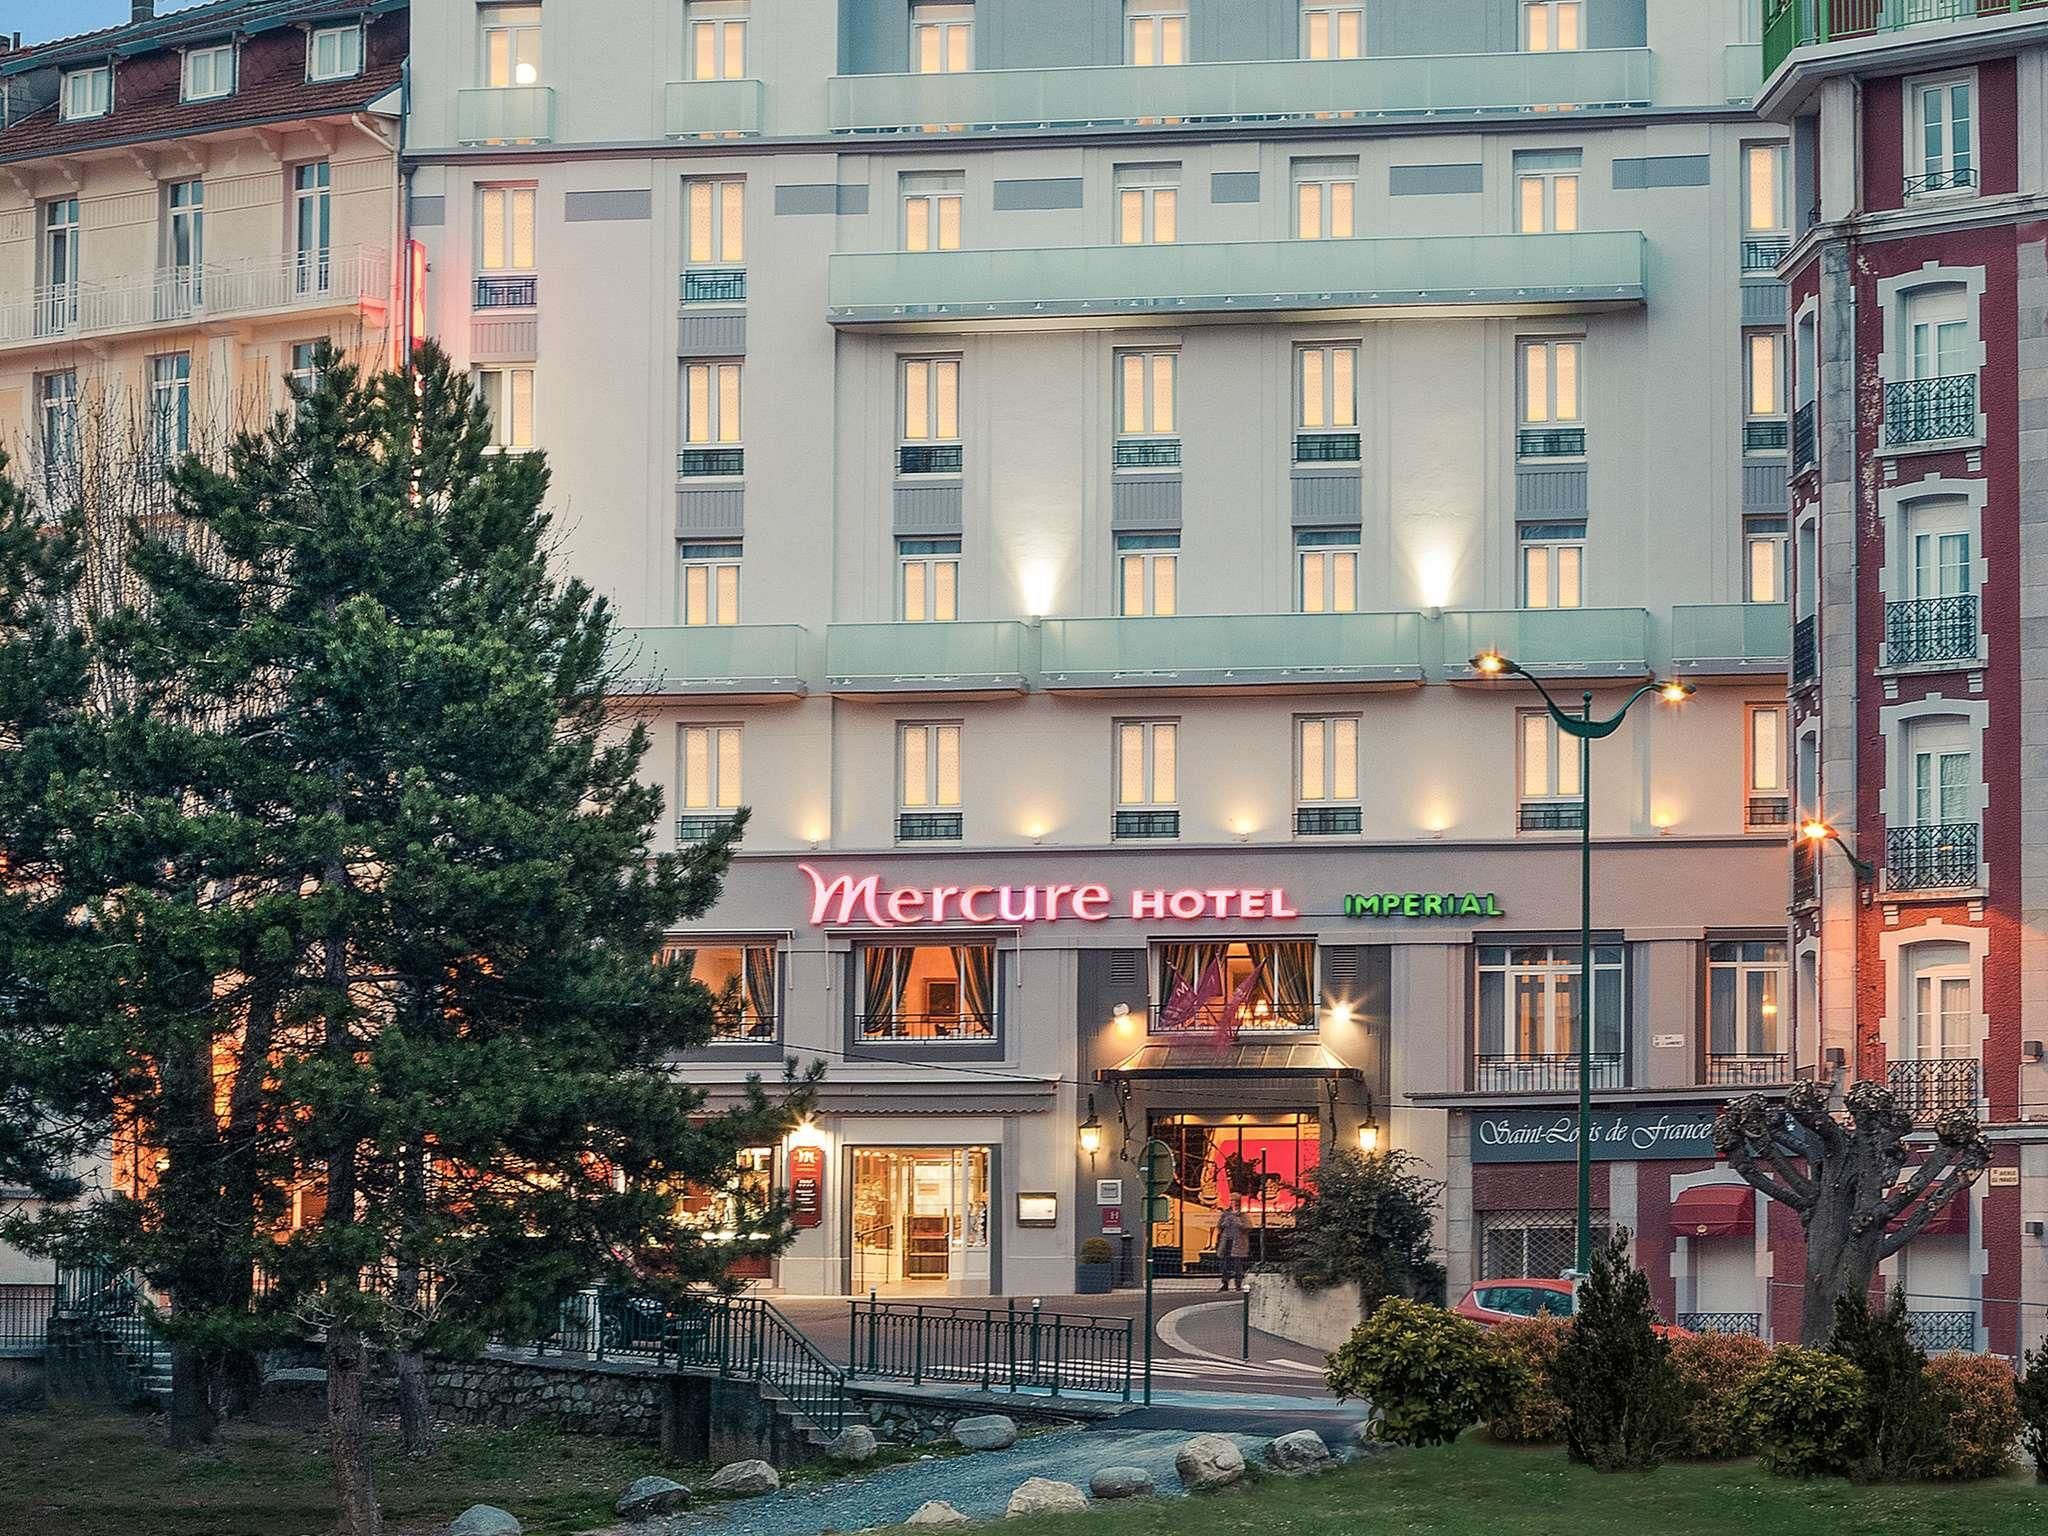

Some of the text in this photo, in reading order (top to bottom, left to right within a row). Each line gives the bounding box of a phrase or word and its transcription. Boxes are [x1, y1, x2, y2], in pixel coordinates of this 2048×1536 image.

[797, 862, 1506, 927] Mercure HOTEL IMPERIAL
[1479, 1115, 1713, 1149] Saint-Lois de France
